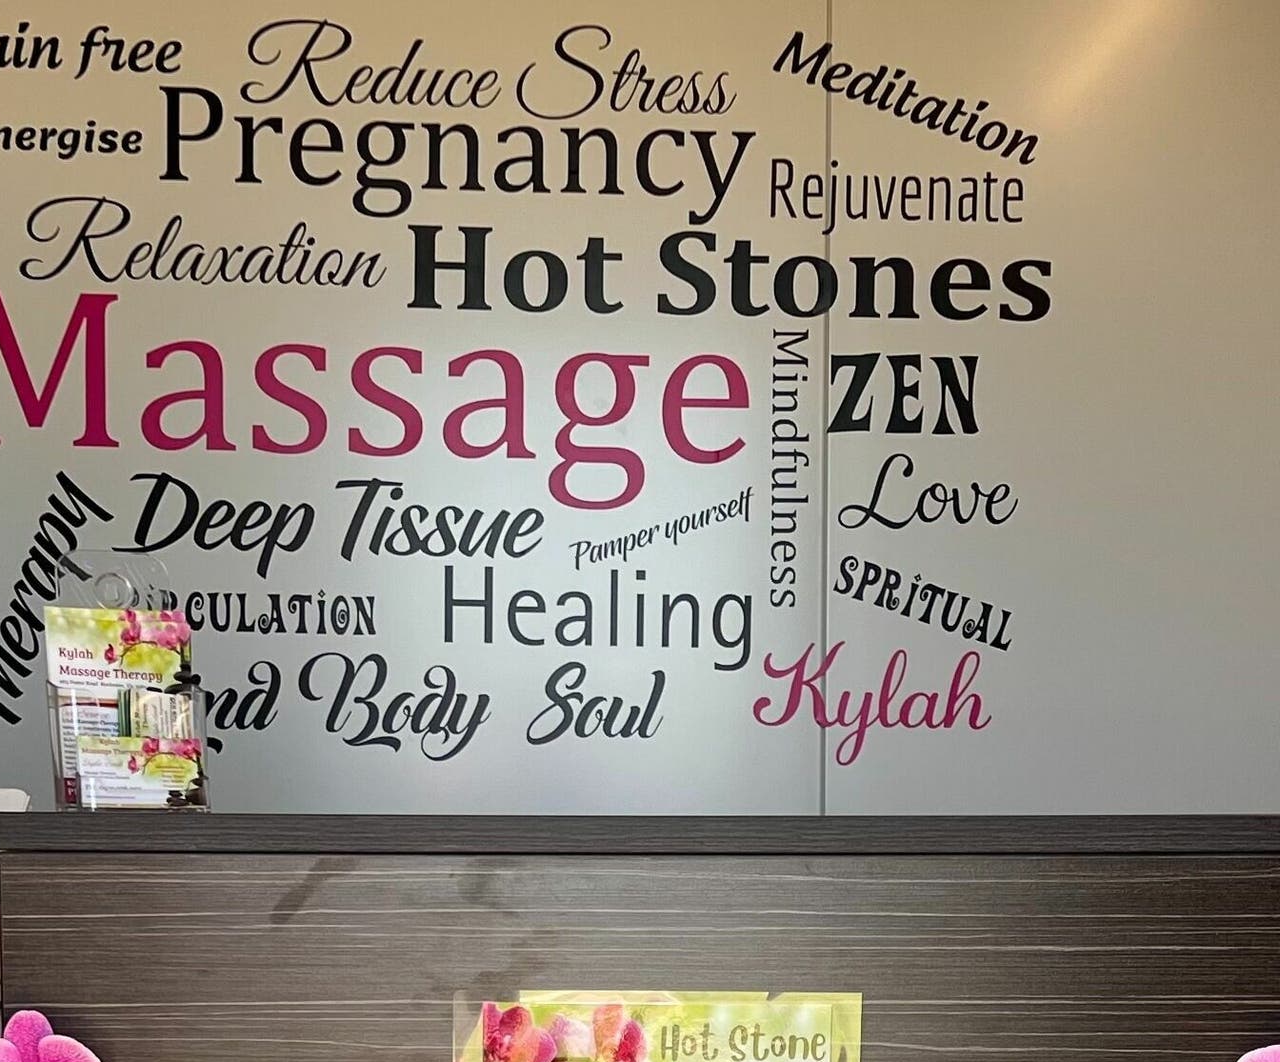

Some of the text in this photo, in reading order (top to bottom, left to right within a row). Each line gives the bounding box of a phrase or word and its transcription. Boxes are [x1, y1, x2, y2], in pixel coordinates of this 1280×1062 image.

[73, 25, 183, 81] free
[239, 18, 738, 121] Reduce Stress
[772, 31, 1040, 165] Meditation
[158, 85, 757, 226] Pregnancy
[770, 157, 1024, 235] Rejuvenate
[18, 195, 388, 289] Relaxation
[406, 223, 1052, 322] Hot Stones
[826, 352, 980, 436] ZEN
[770, 328, 810, 608] Mindfulness
[837, 453, 1019, 530] Love
[111, 471, 545, 580] Deep Tissue
[569, 486, 754, 571] Pamper yourself
[58, 647, 93, 661] Kylah
[443, 564, 753, 672] Healing
[59, 665, 163, 683] Massage Therapy
[297, 651, 492, 762] Body
[526, 661, 666, 746] Soul
[752, 640, 992, 767] Kylah
[661, 1023, 827, 1062] Hot Stone
